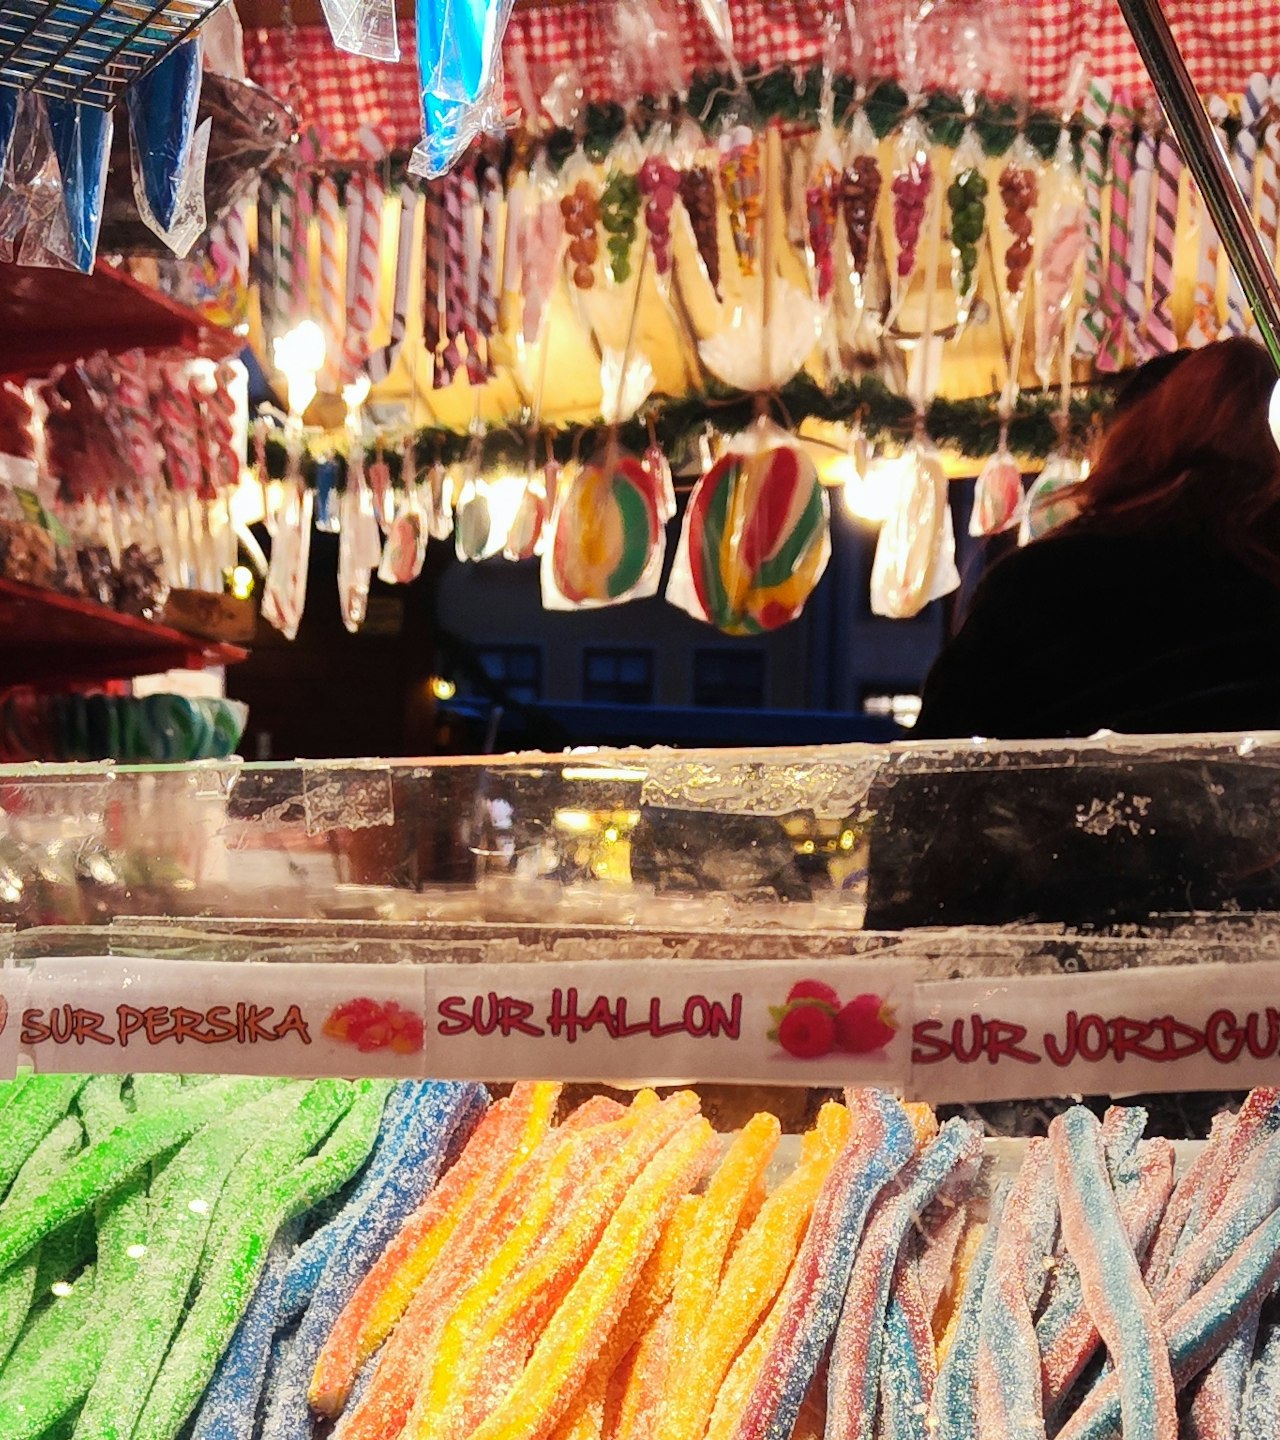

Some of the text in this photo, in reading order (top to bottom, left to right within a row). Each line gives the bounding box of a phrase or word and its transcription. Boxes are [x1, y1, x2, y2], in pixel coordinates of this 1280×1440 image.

[20, 1002, 312, 1046] SUR PERSIKA
[437, 987, 743, 1043] SUR HALLON
[911, 1014, 1042, 1065] SUR
